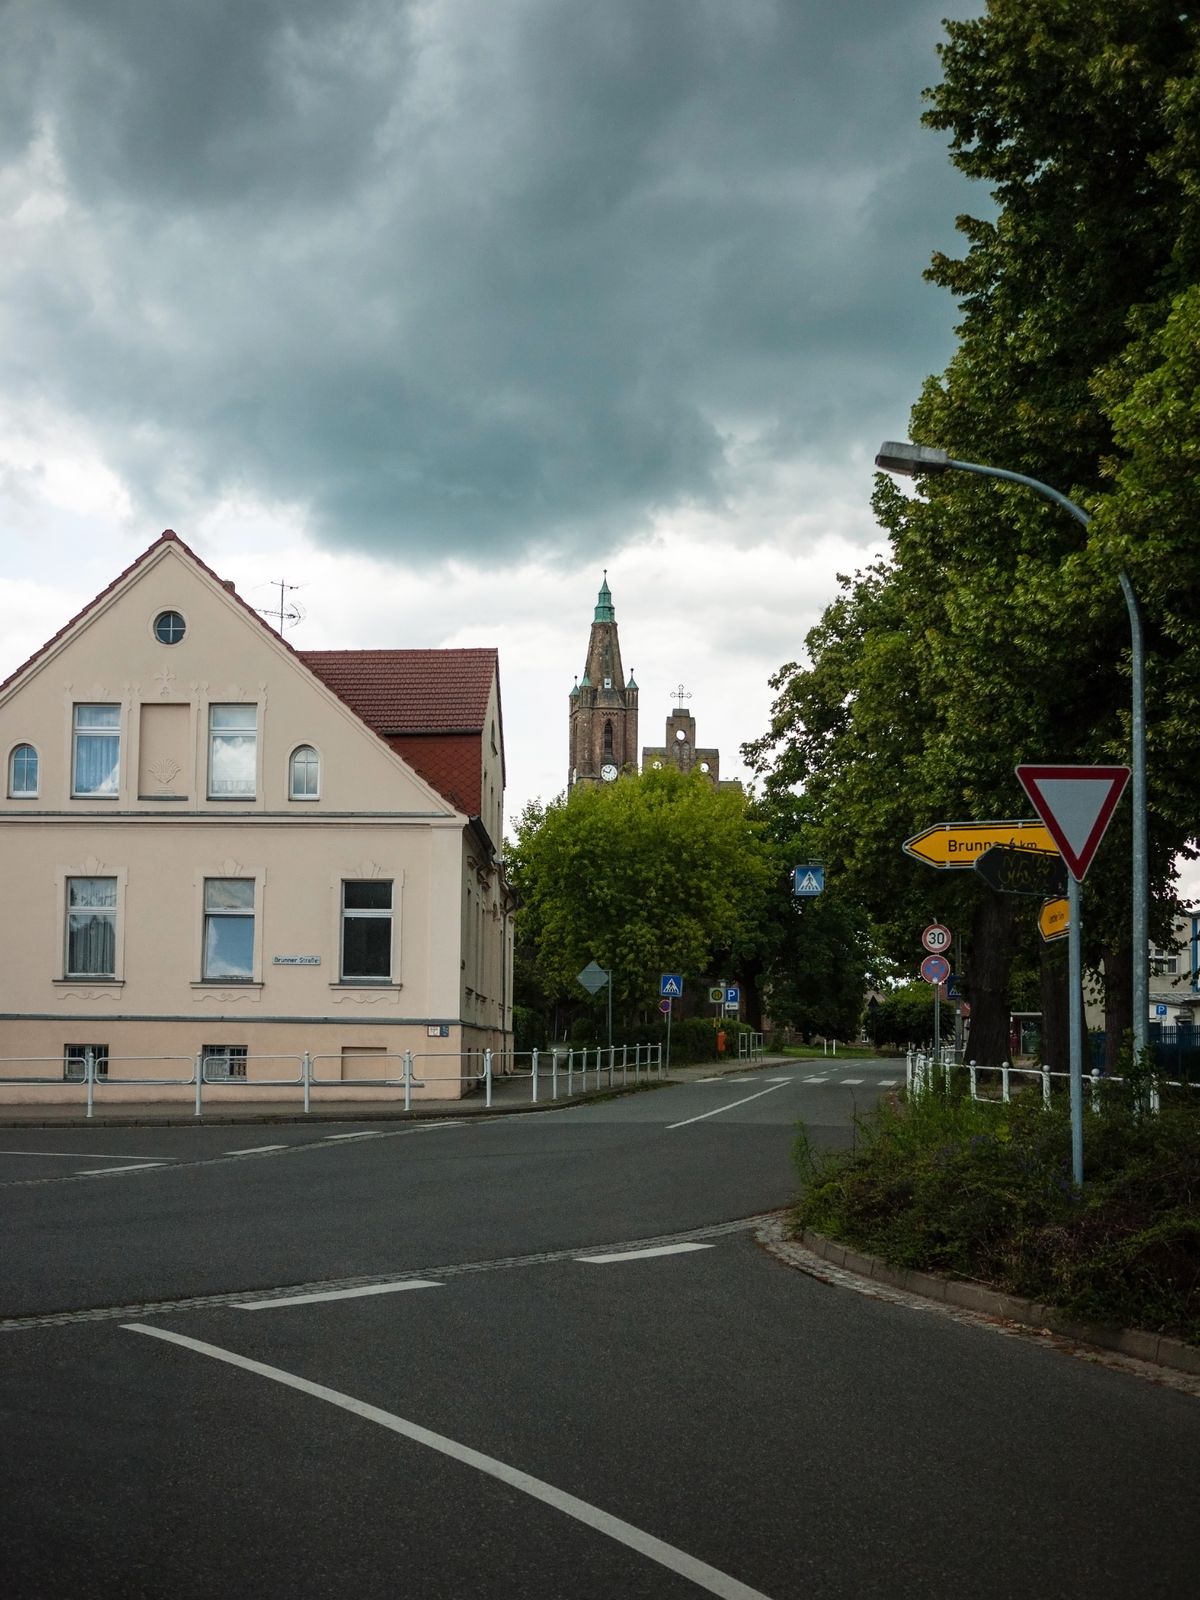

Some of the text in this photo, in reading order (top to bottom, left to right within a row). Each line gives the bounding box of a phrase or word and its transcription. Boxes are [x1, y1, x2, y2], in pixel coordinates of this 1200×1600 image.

[948, 839, 1000, 852] Brunn
[1020, 839, 1037, 849] km
[928, 932, 945, 945] 30
[727, 990, 736, 1001] P
[1158, 1005, 1165, 1014] P
